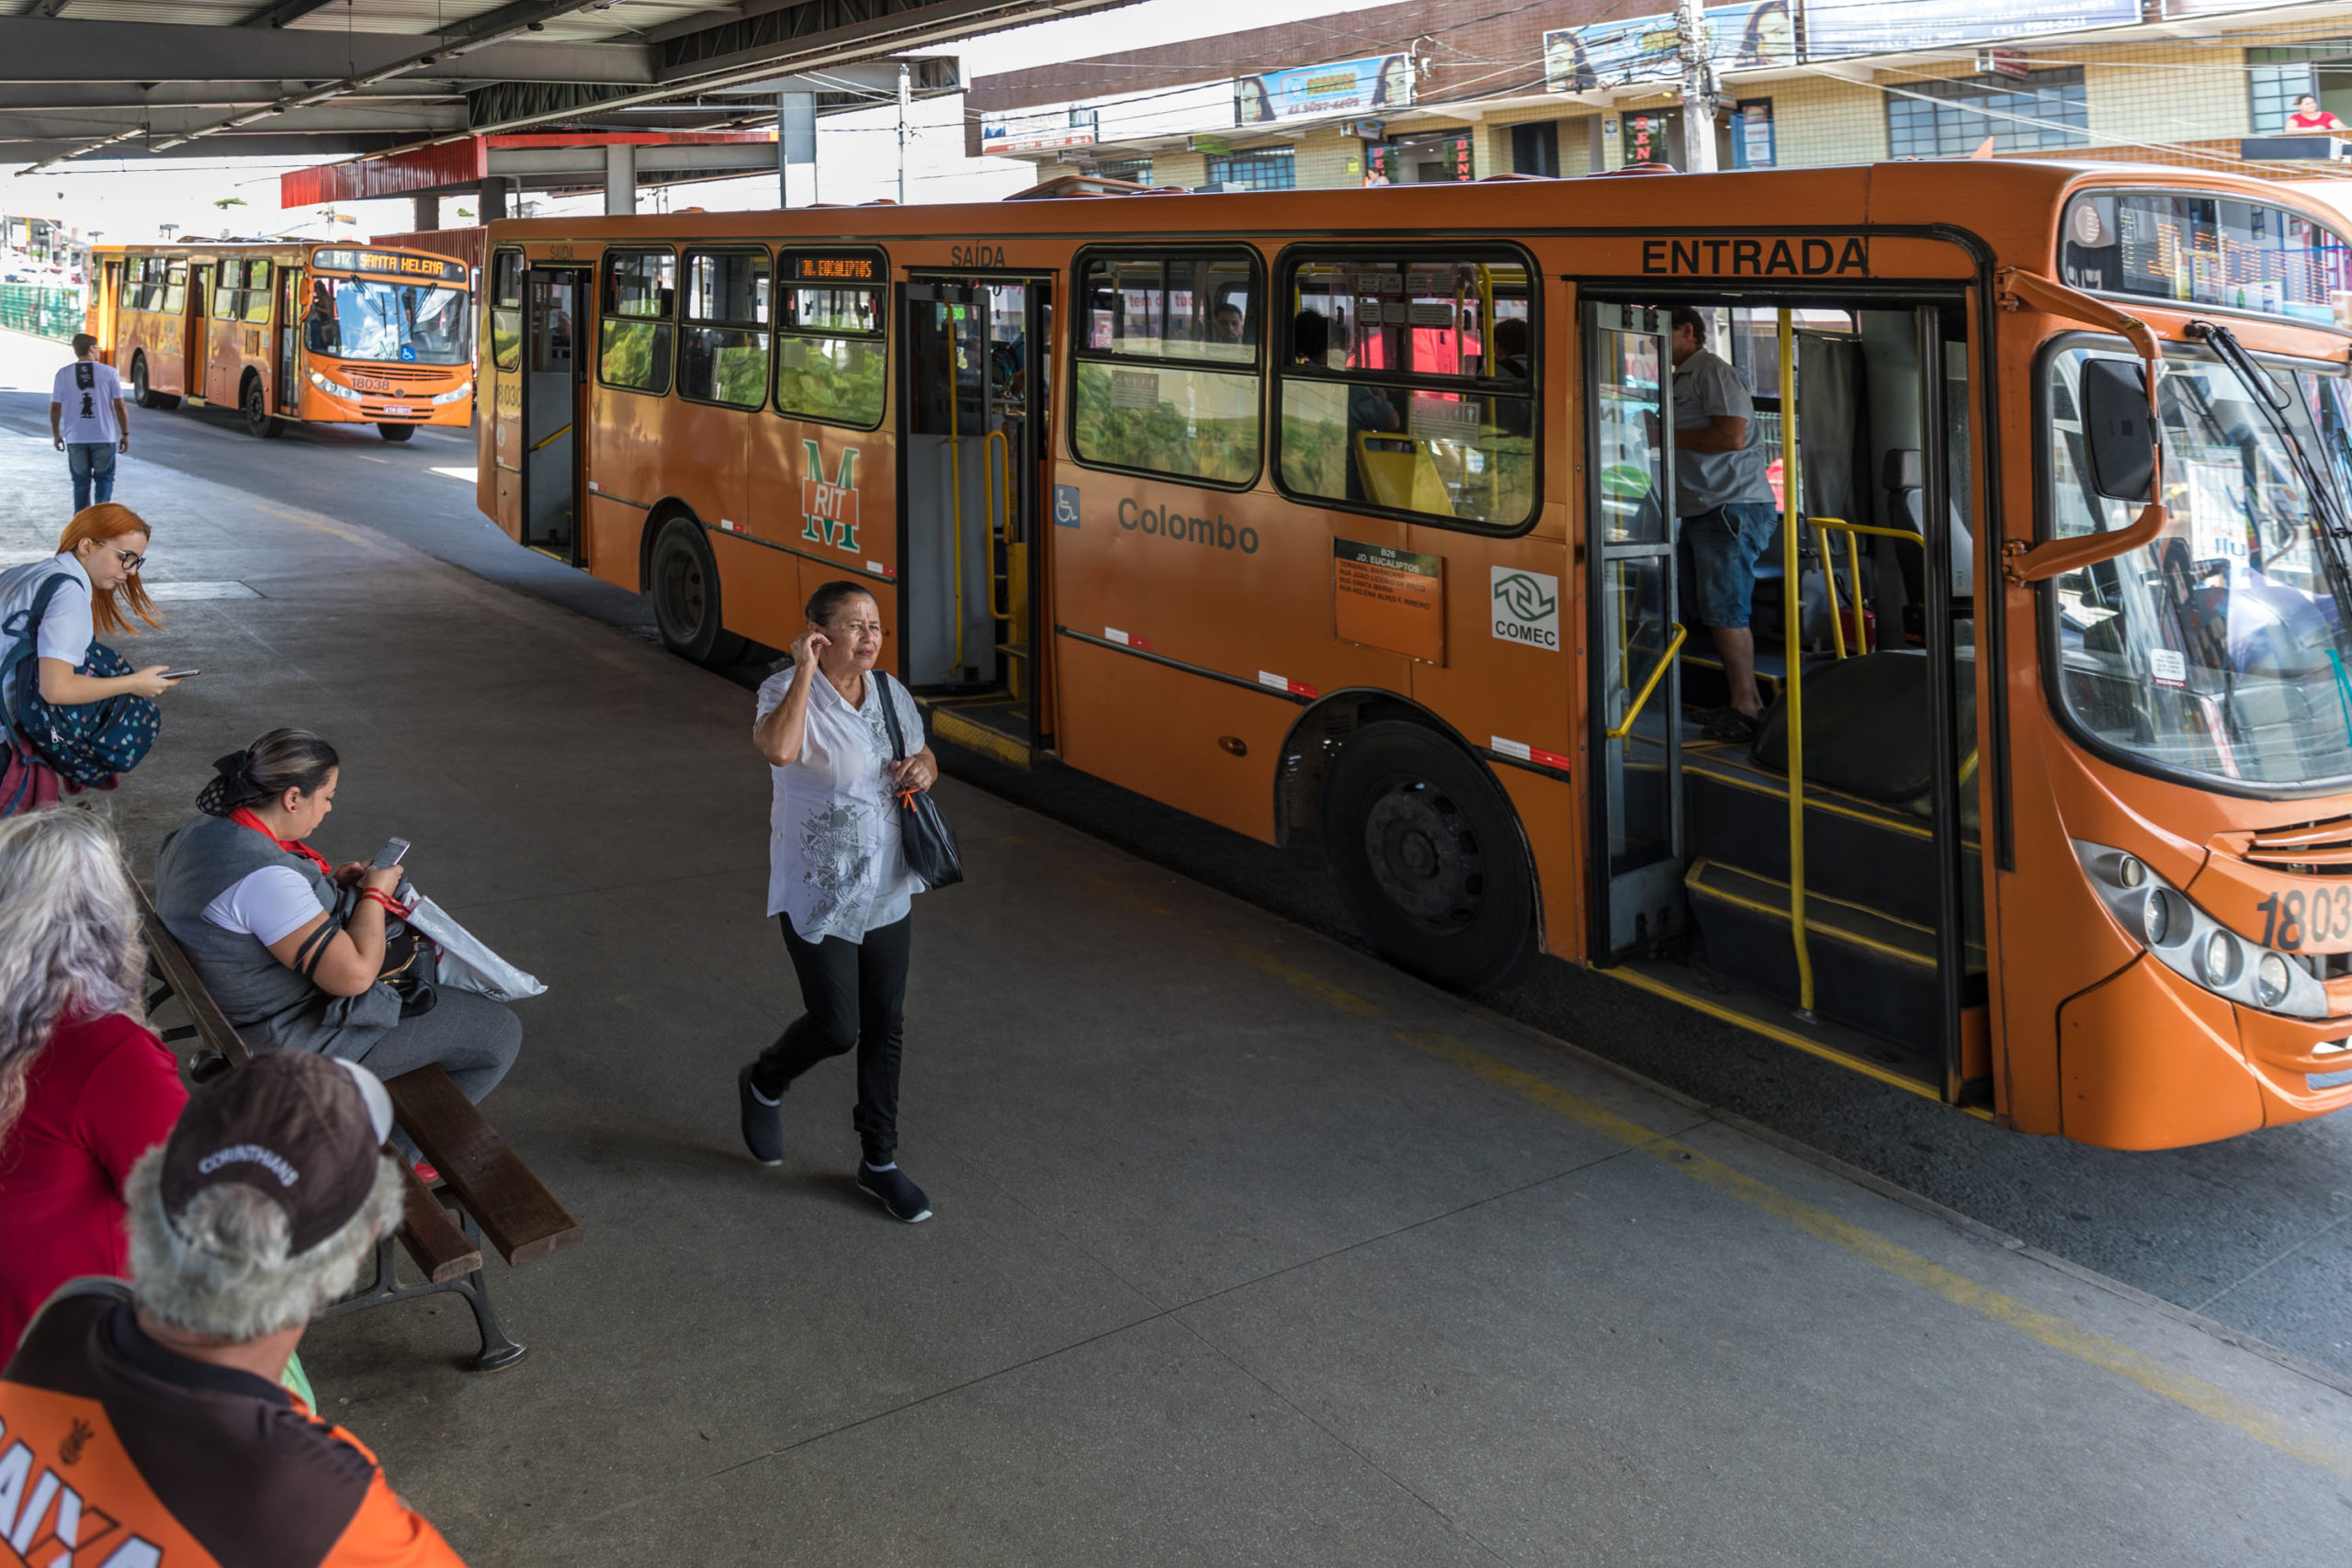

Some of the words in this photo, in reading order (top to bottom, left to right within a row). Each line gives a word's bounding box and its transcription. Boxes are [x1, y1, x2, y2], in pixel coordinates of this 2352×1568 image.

[333, 251, 352, 265] B17
[359, 254, 397, 271] SANTA
[401, 258, 444, 275] HELENA
[951, 239, 1006, 268] SAÍDA
[1643, 236, 1869, 278] ENTRADA
[352, 378, 390, 391] 18038
[813, 488, 848, 520] RIT
[1118, 497, 1260, 554] Colombo
[1356, 553, 1368, 563] JD.
[1370, 556, 1420, 573] EUCALIPTOS
[1381, 548, 1396, 558] B26
[1339, 584, 1351, 592] RUA
[1352, 588, 1376, 598] HELENA
[1377, 593, 1396, 604] ALVES
[1352, 579, 1372, 588] SANTA
[1374, 583, 1394, 593] MARIA
[1495, 619, 1556, 646] COMEC
[198, 1143, 300, 1188] CORINTHIANS
[0, 1415, 165, 1568] AIX
